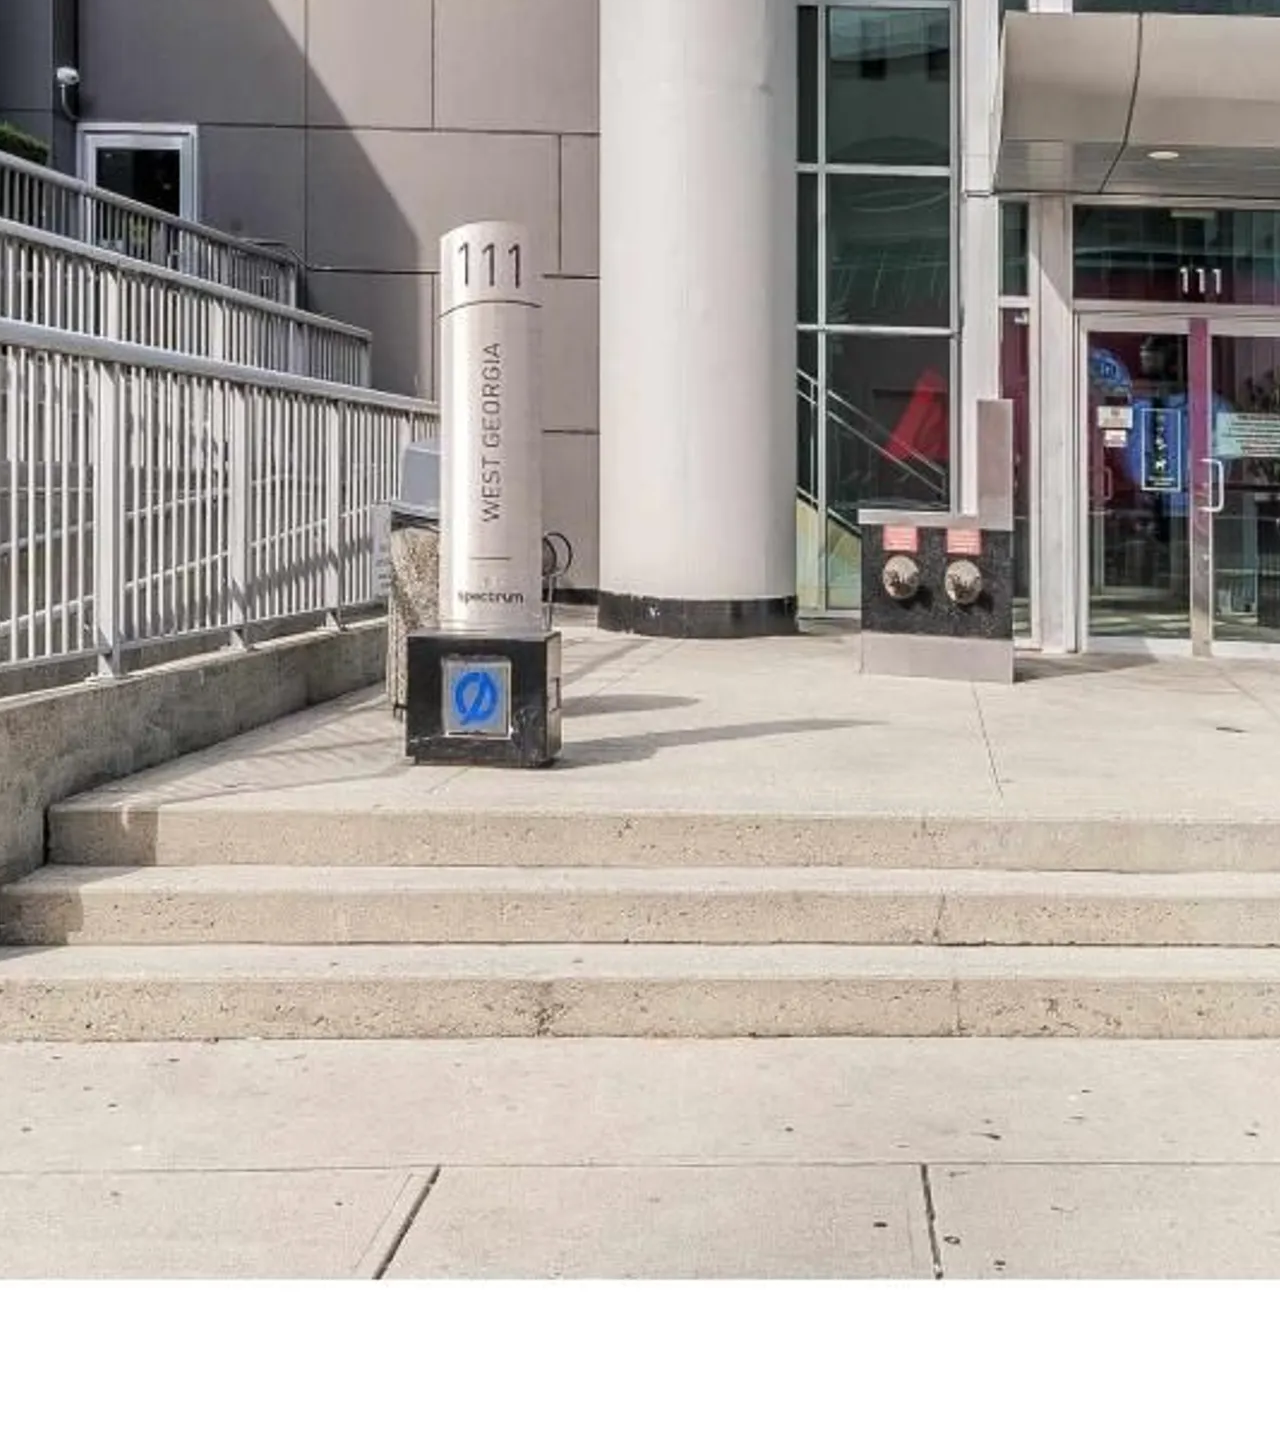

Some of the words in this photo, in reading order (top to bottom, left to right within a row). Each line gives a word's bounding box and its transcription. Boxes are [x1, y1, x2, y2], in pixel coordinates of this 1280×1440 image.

[458, 242, 521, 288] 111
[1179, 266, 1222, 295] 111
[481, 342, 502, 448] GEORGIA
[481, 456, 501, 523] WEST
[457, 591, 524, 606] spectrum
